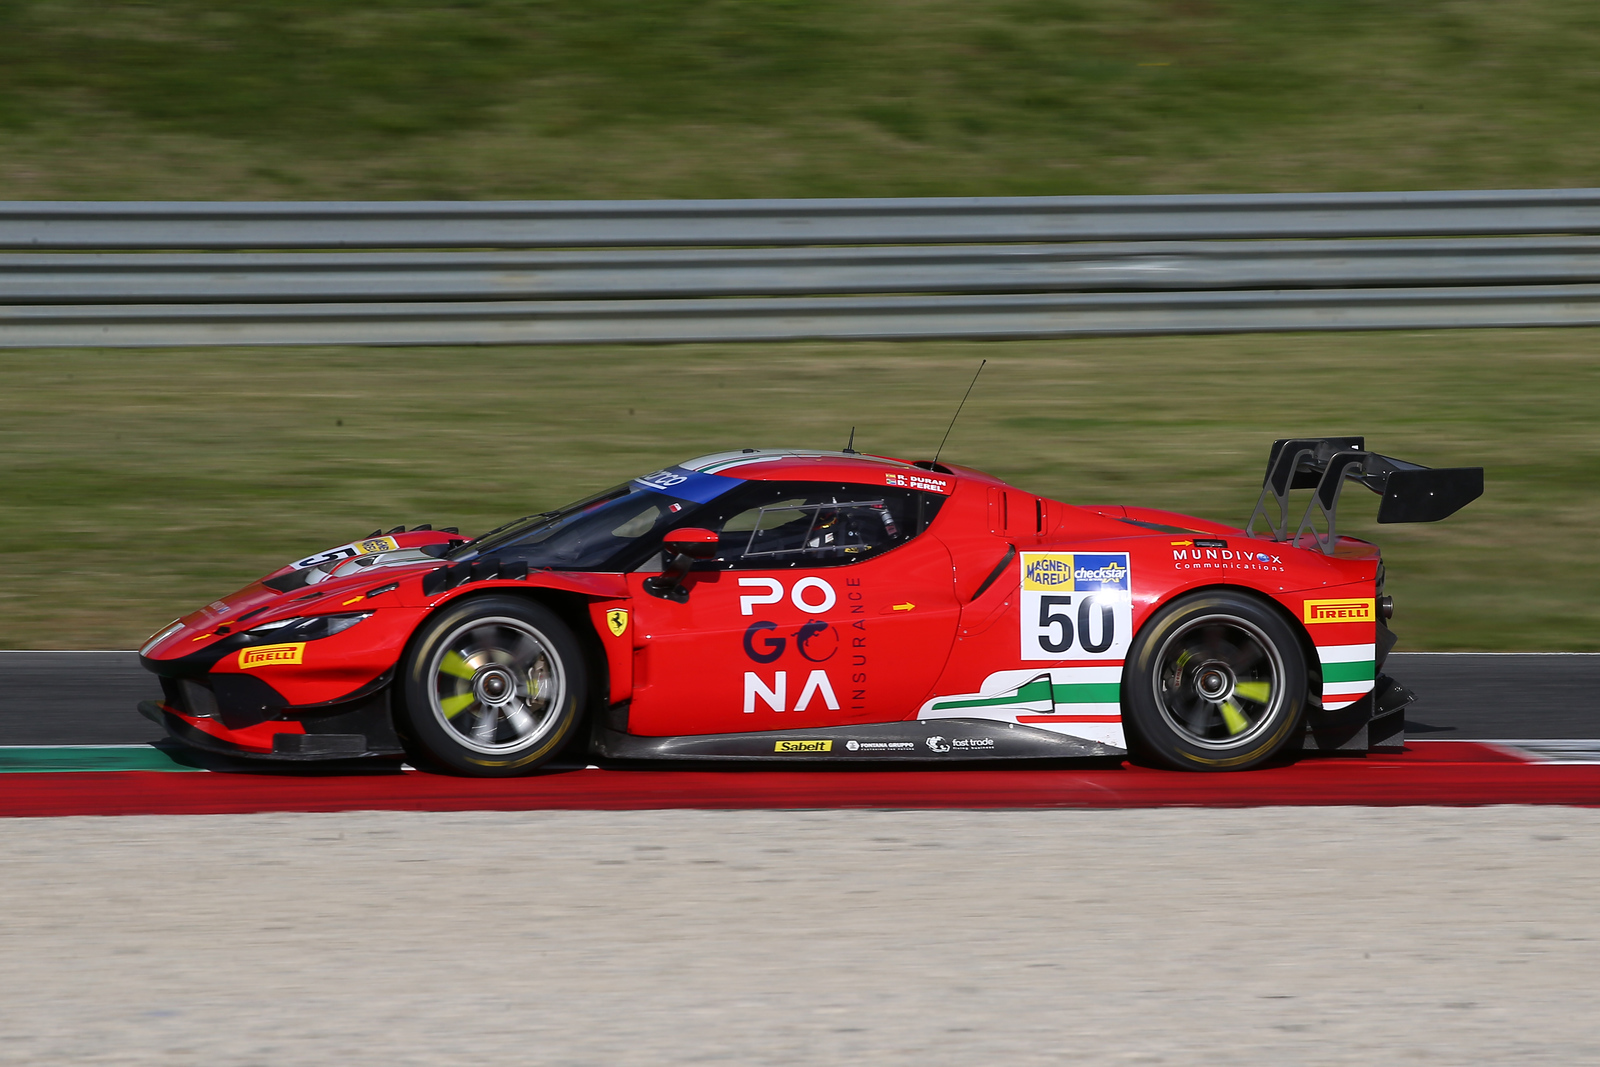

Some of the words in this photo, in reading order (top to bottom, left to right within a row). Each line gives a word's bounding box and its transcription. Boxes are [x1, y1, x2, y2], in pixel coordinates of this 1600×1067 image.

[910, 476, 947, 486] DURAN
[910, 481, 944, 492] PEREL
[1173, 549, 1282, 564] MUNDIVOX
[1027, 559, 1071, 573] MAGNETI
[1074, 566, 1127, 580] checkstar
[1175, 562, 1285, 572] Communications
[738, 576, 837, 616] PO
[1310, 603, 1370, 619] PIRELLI
[1038, 595, 1115, 654] 50
[846, 577, 867, 709] INSURANCE
[243, 647, 298, 664] PIRELLI
[743, 670, 841, 713] NA
[781, 742, 827, 752] Sabelt
[952, 738, 969, 747] fast
[969, 737, 994, 746] trade
